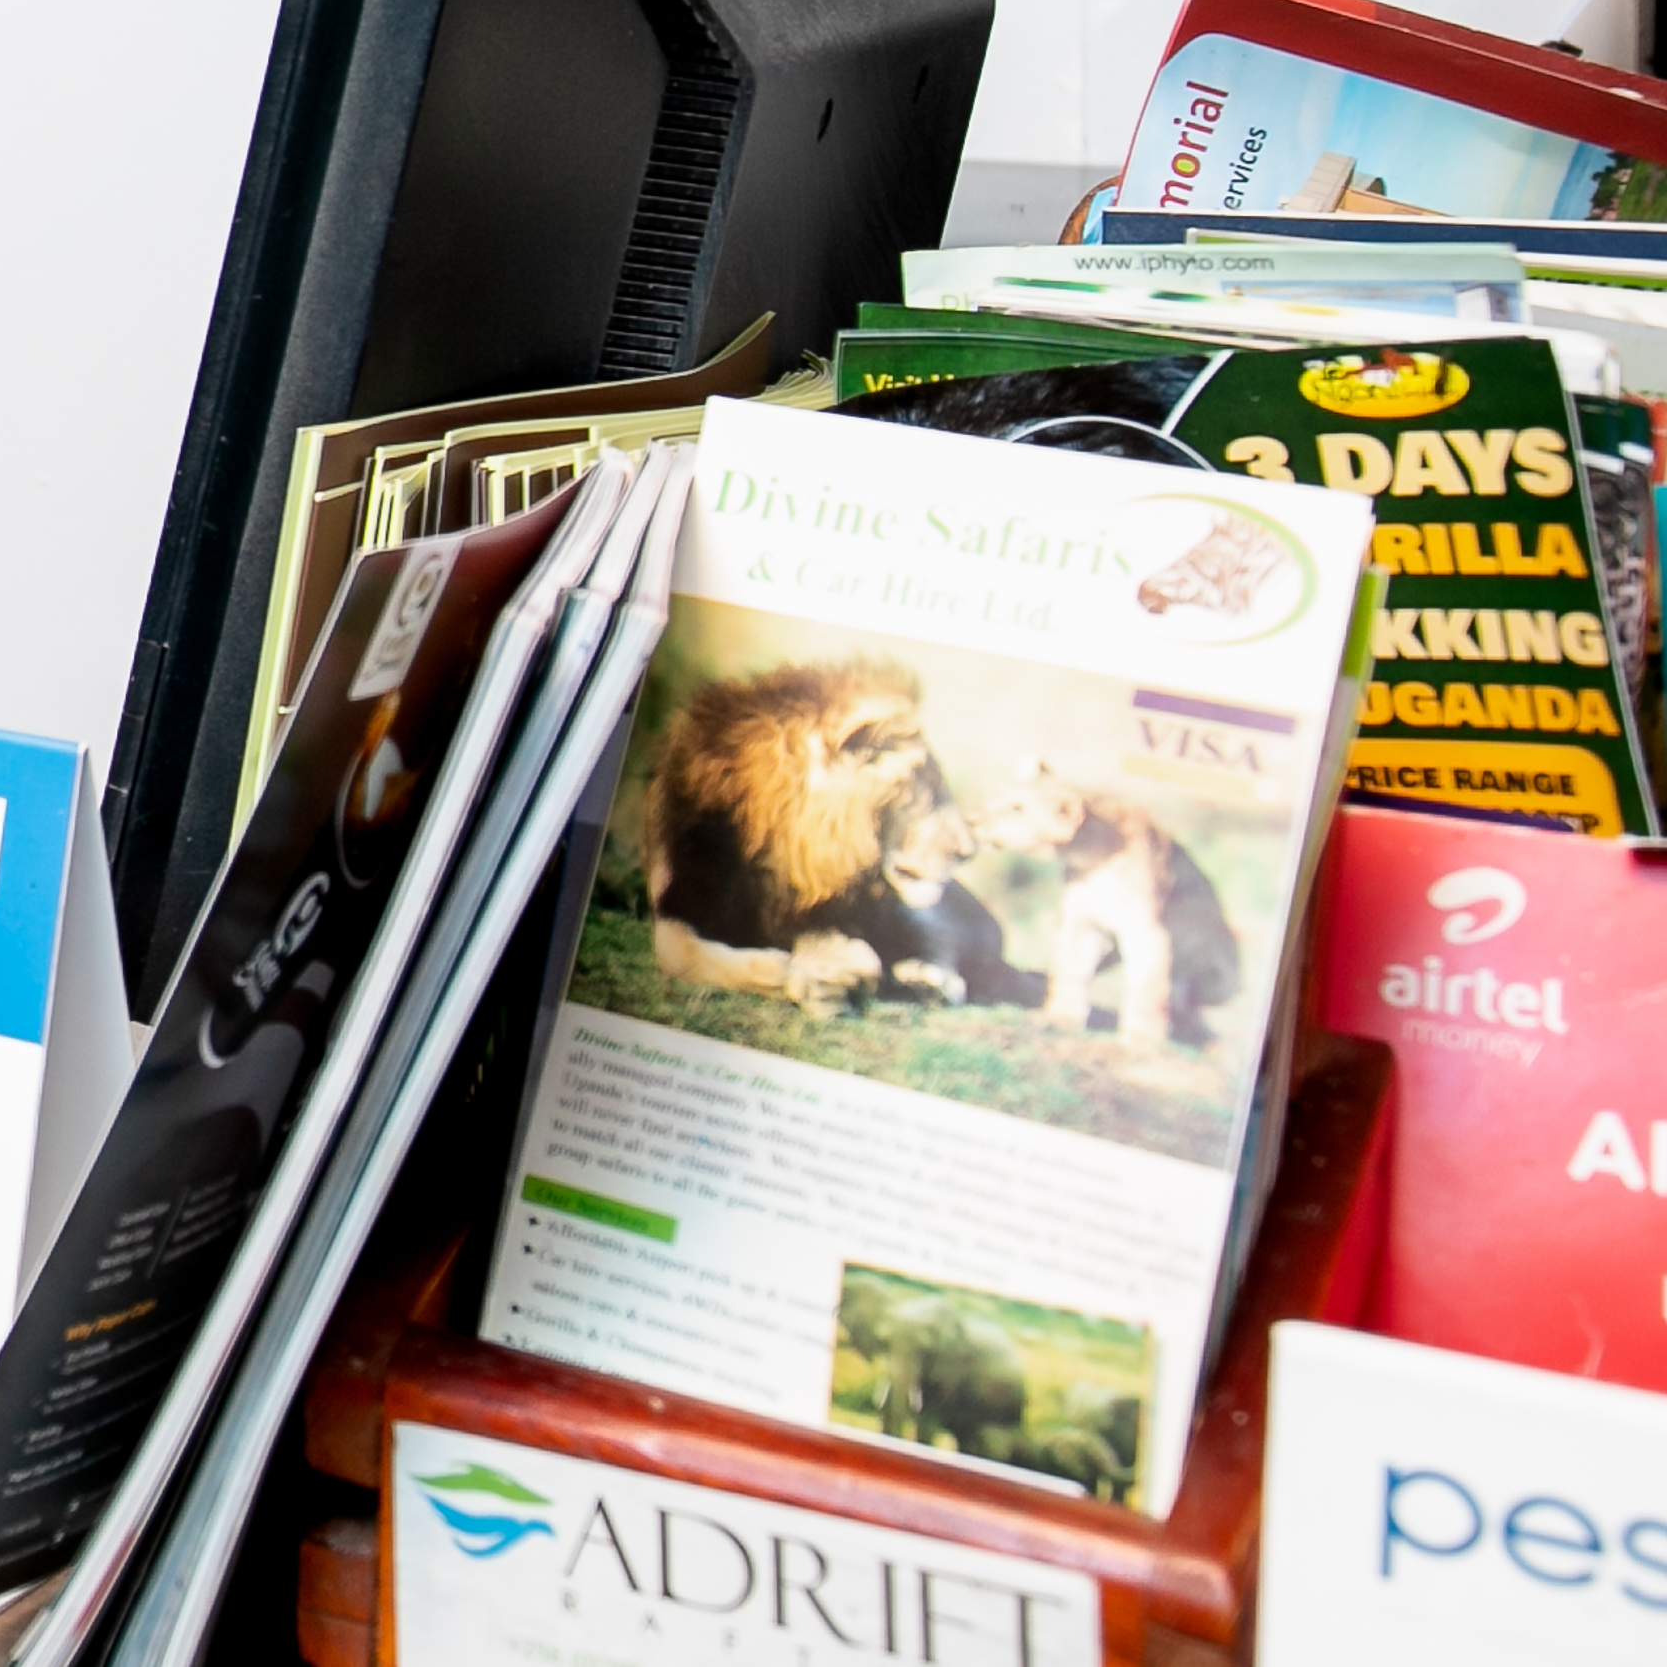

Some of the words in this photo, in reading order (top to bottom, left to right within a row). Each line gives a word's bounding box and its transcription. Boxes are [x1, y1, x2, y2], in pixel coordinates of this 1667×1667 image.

[1159, 80, 1230, 209] morial
[1222, 125, 1267, 213] ervices
[1224, 435, 1295, 483] 3
[1315, 426, 1574, 499] DAYS
[712, 465, 901, 543] Divine
[917, 499, 1138, 583] Safaris
[1367, 522, 1588, 578] RILLA
[1373, 607, 1610, 668] KKING
[1137, 718, 1264, 774] VISA
[1346, 765, 1441, 791] RICE
[1454, 768, 1578, 796] RANGE
[1379, 954, 1568, 1035] airtel
[565, 1494, 1073, 1667] ADRIFT
